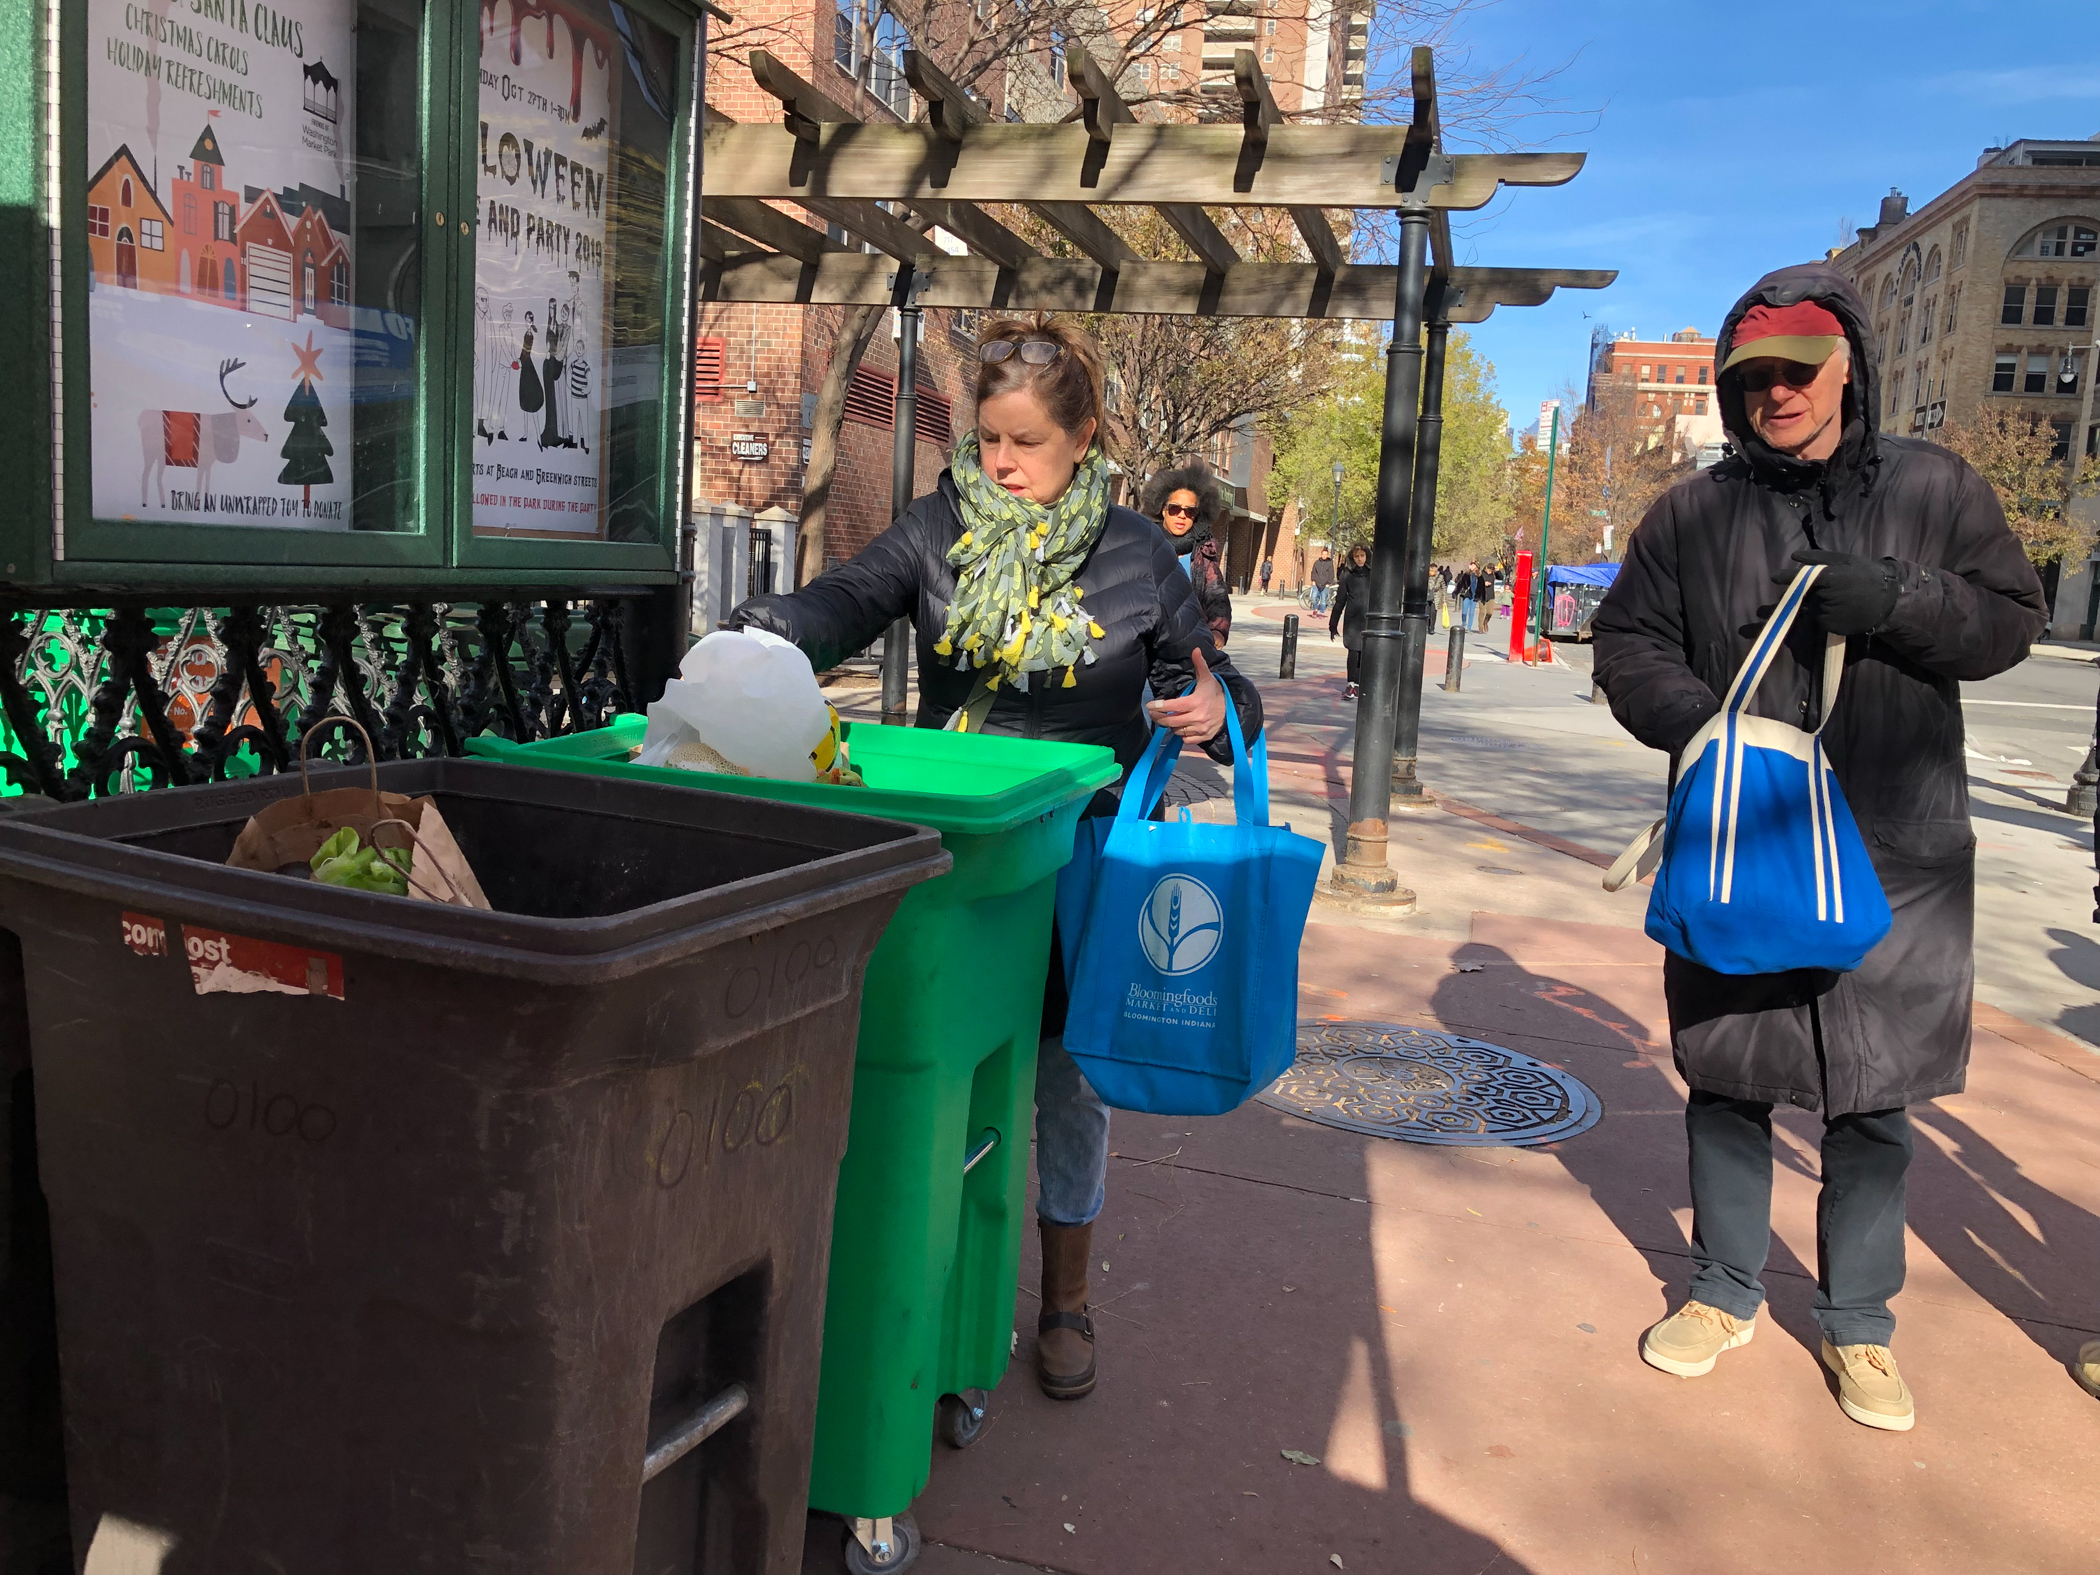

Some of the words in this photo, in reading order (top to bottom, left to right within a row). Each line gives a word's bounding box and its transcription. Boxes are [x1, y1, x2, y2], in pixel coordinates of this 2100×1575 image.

[125, 3, 203, 58] CHRISTMAS
[206, 36, 249, 76] CAROLS
[254, 3, 304, 58] CLAUS
[107, 37, 162, 81] HOLIDAY
[165, 59, 263, 119] REFRESHMENTS
[302, 124, 338, 147] Washington
[302, 136, 323, 153] Market
[323, 146, 338, 159] Park
[732, 442, 768, 456] CLEANERS
[486, 465, 495, 477] AT
[520, 469, 535, 481] AND
[573, 475, 598, 488] STREETS
[171, 490, 200, 512] BRING
[204, 492, 217, 513] AN
[220, 494, 279, 517] UNWRAPPED
[280, 498, 299, 518] TOY
[301, 500, 312, 519] TO
[313, 501, 343, 520] DONATE
[499, 495, 506, 507] IN
[508, 496, 521, 508] THE
[523, 497, 541, 509] PARK
[543, 499, 566, 512] DURING
[567, 501, 578, 513] THE
[579, 503, 598, 515] PARTY
[1128, 982, 1218, 1008] Bloomingfoods
[1125, 998, 1168, 1012] MARKET
[1189, 1005, 1217, 1017] DELI
[1123, 1011, 1179, 1025] BLOOMINGTON
[1181, 1019, 1216, 1029] INDIANA
